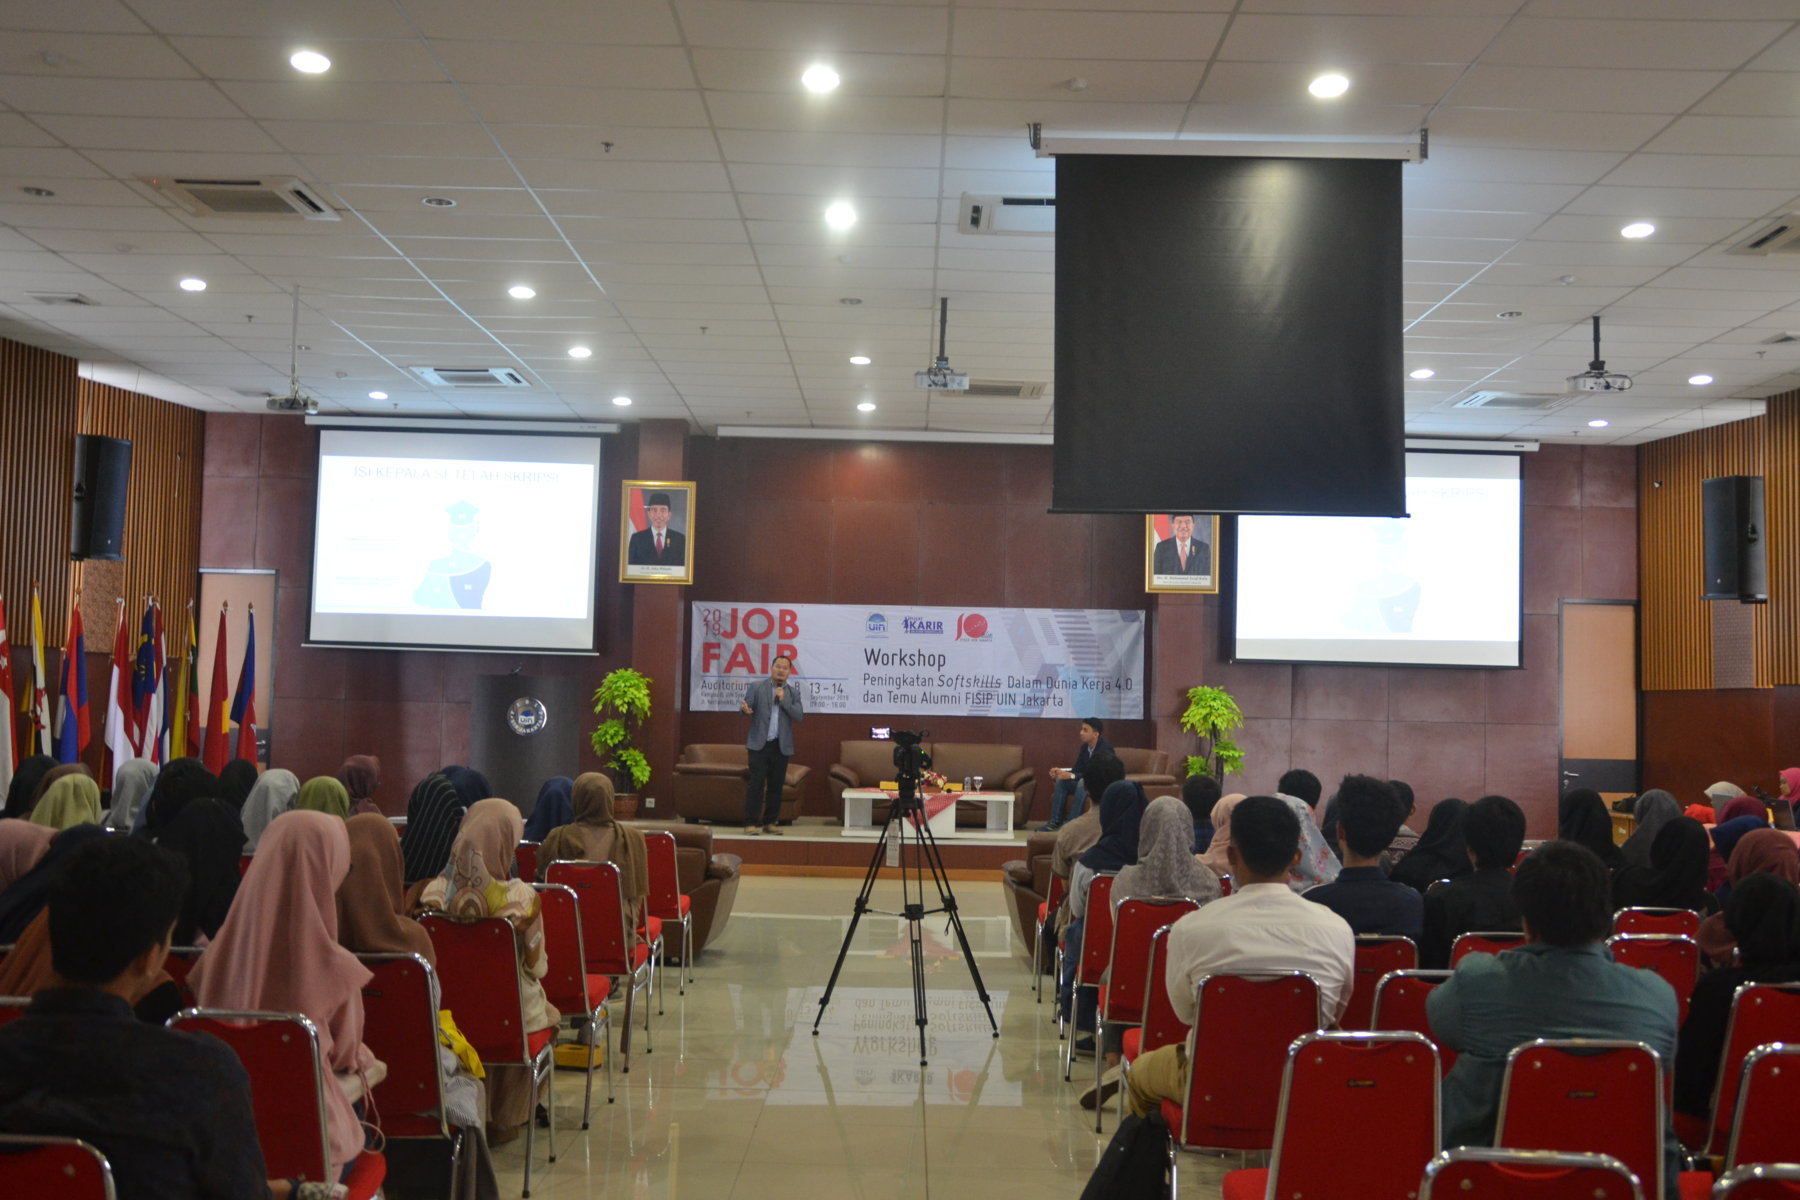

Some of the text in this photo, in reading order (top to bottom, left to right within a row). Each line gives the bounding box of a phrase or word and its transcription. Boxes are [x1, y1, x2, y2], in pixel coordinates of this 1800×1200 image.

[703, 609, 721, 621] 20
[720, 607, 800, 640] JOB
[909, 621, 944, 630] KARIR
[702, 642, 799, 675] FAIR
[864, 647, 947, 671] Workshop
[810, 682, 821, 694] 13
[832, 683, 844, 694] 14
[863, 673, 1132, 693] Peningkatan Softskills Dalam Dunia Kerja 4.0
[863, 691, 1064, 706] dan Temu Alumni FISIP UIN Jakarta
